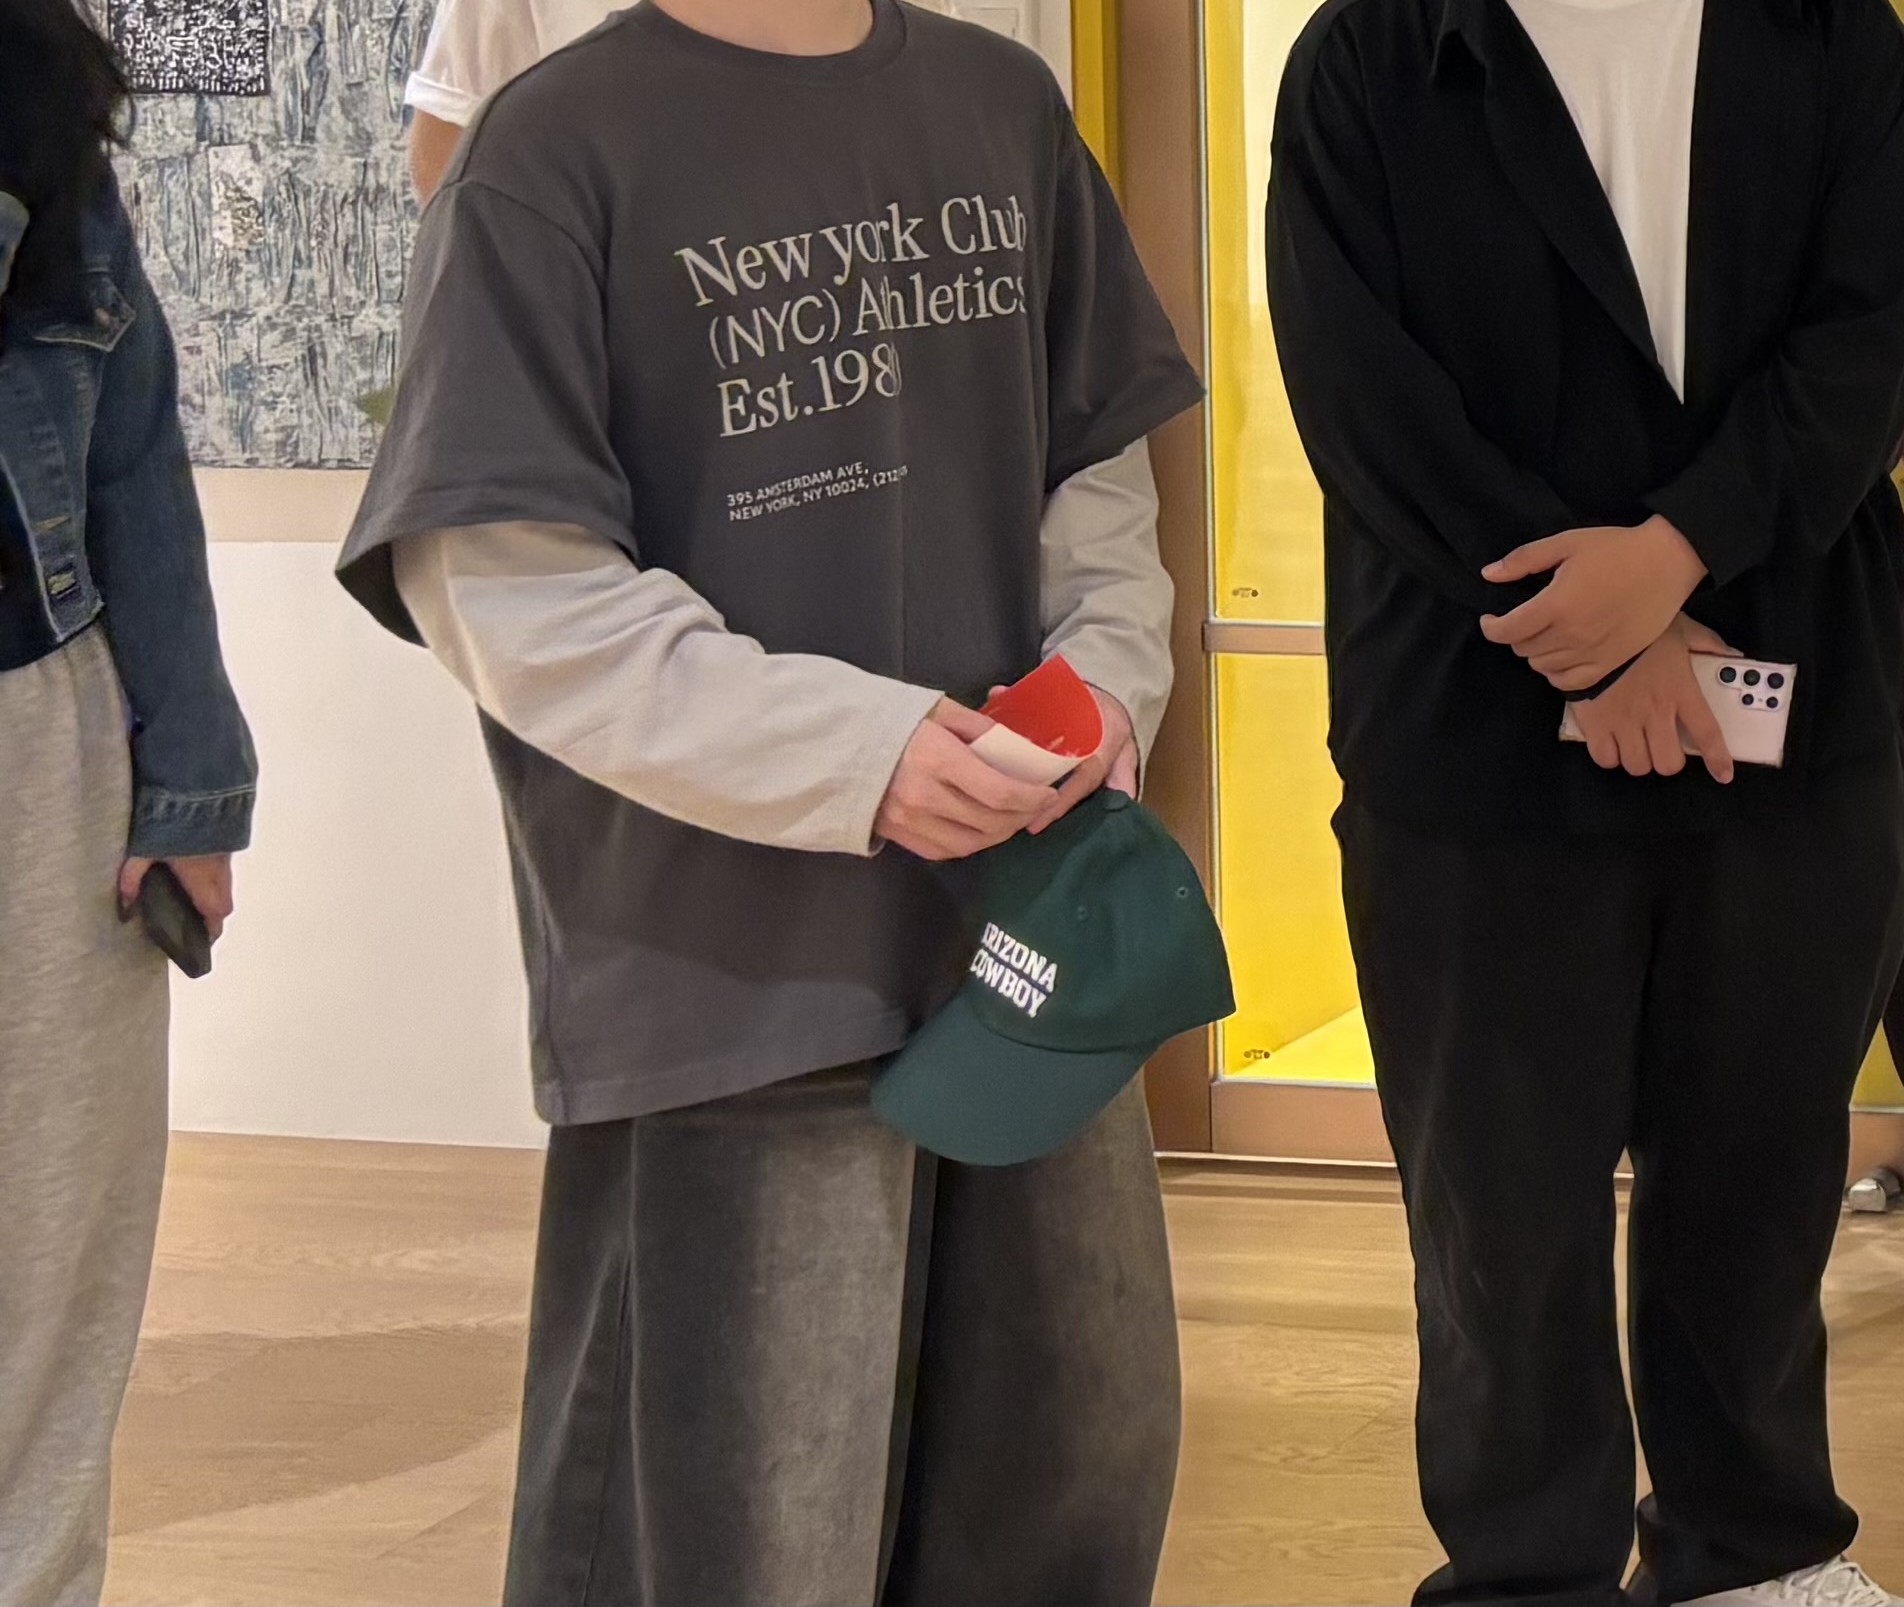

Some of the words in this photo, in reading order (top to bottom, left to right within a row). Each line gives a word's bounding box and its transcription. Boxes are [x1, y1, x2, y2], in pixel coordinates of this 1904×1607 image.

[674, 236, 813, 307] New
[819, 202, 930, 286] york
[940, 194, 1027, 256] Club
[709, 288, 841, 370] (NYC)
[727, 492, 753, 507] 395
[729, 504, 763, 522] NEW
[803, 487, 822, 503] NY
